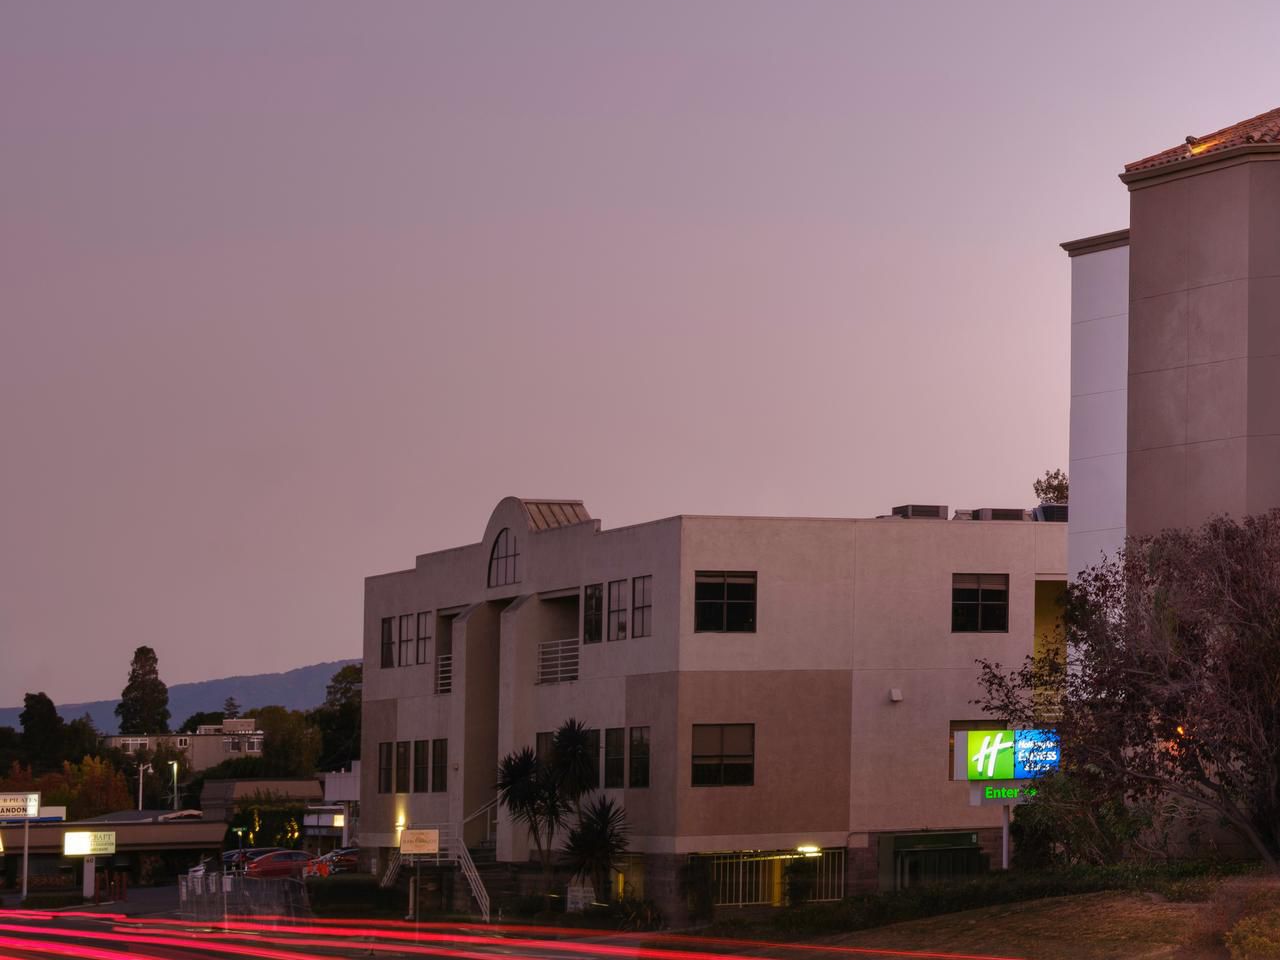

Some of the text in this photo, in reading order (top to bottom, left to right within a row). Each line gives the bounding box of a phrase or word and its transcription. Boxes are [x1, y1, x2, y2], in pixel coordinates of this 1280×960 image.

[1018, 740, 1045, 750] Holiy
[972, 732, 1015, 777] H
[984, 786, 1020, 799] Enter
